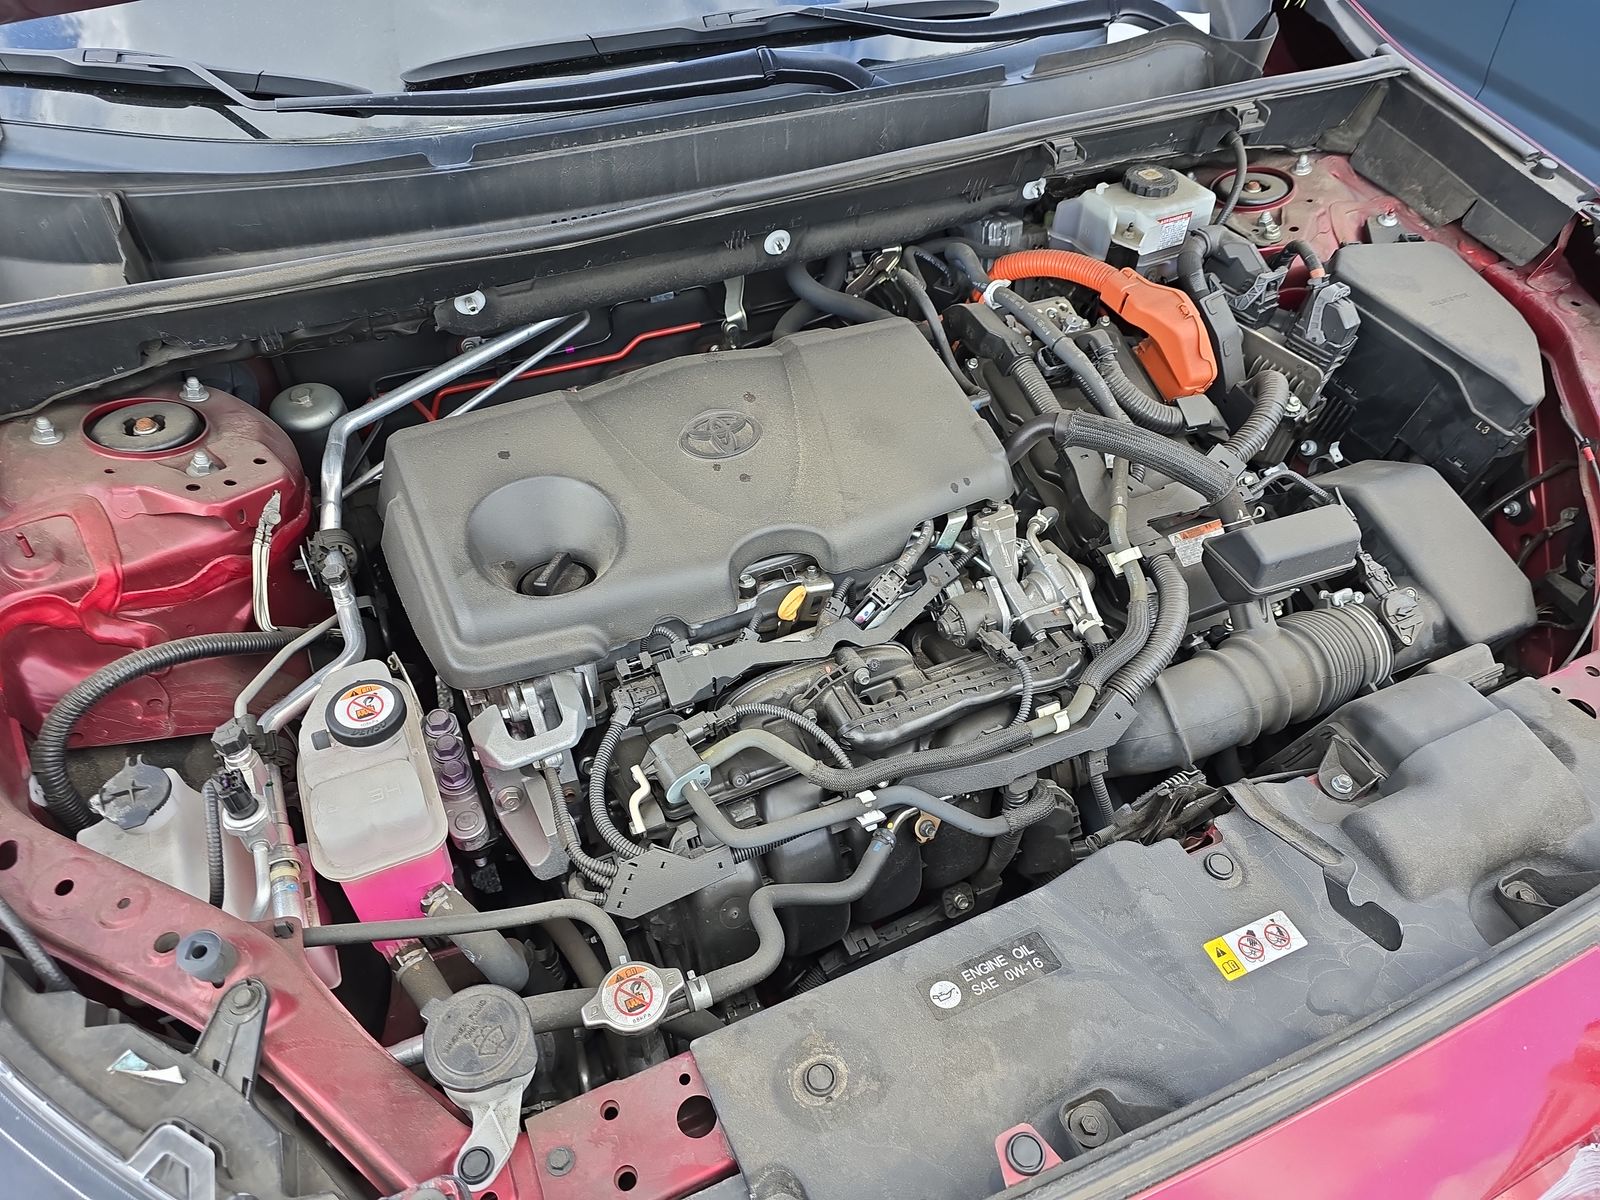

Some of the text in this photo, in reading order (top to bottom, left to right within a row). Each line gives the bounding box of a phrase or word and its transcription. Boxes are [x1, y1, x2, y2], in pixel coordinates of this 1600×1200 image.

[1475, 420, 1490, 435] L3
[350, 722, 387, 736] DENSO
[961, 944, 1035, 982] ENGINE OIL
[971, 957, 1044, 996] SAE 0W-16
